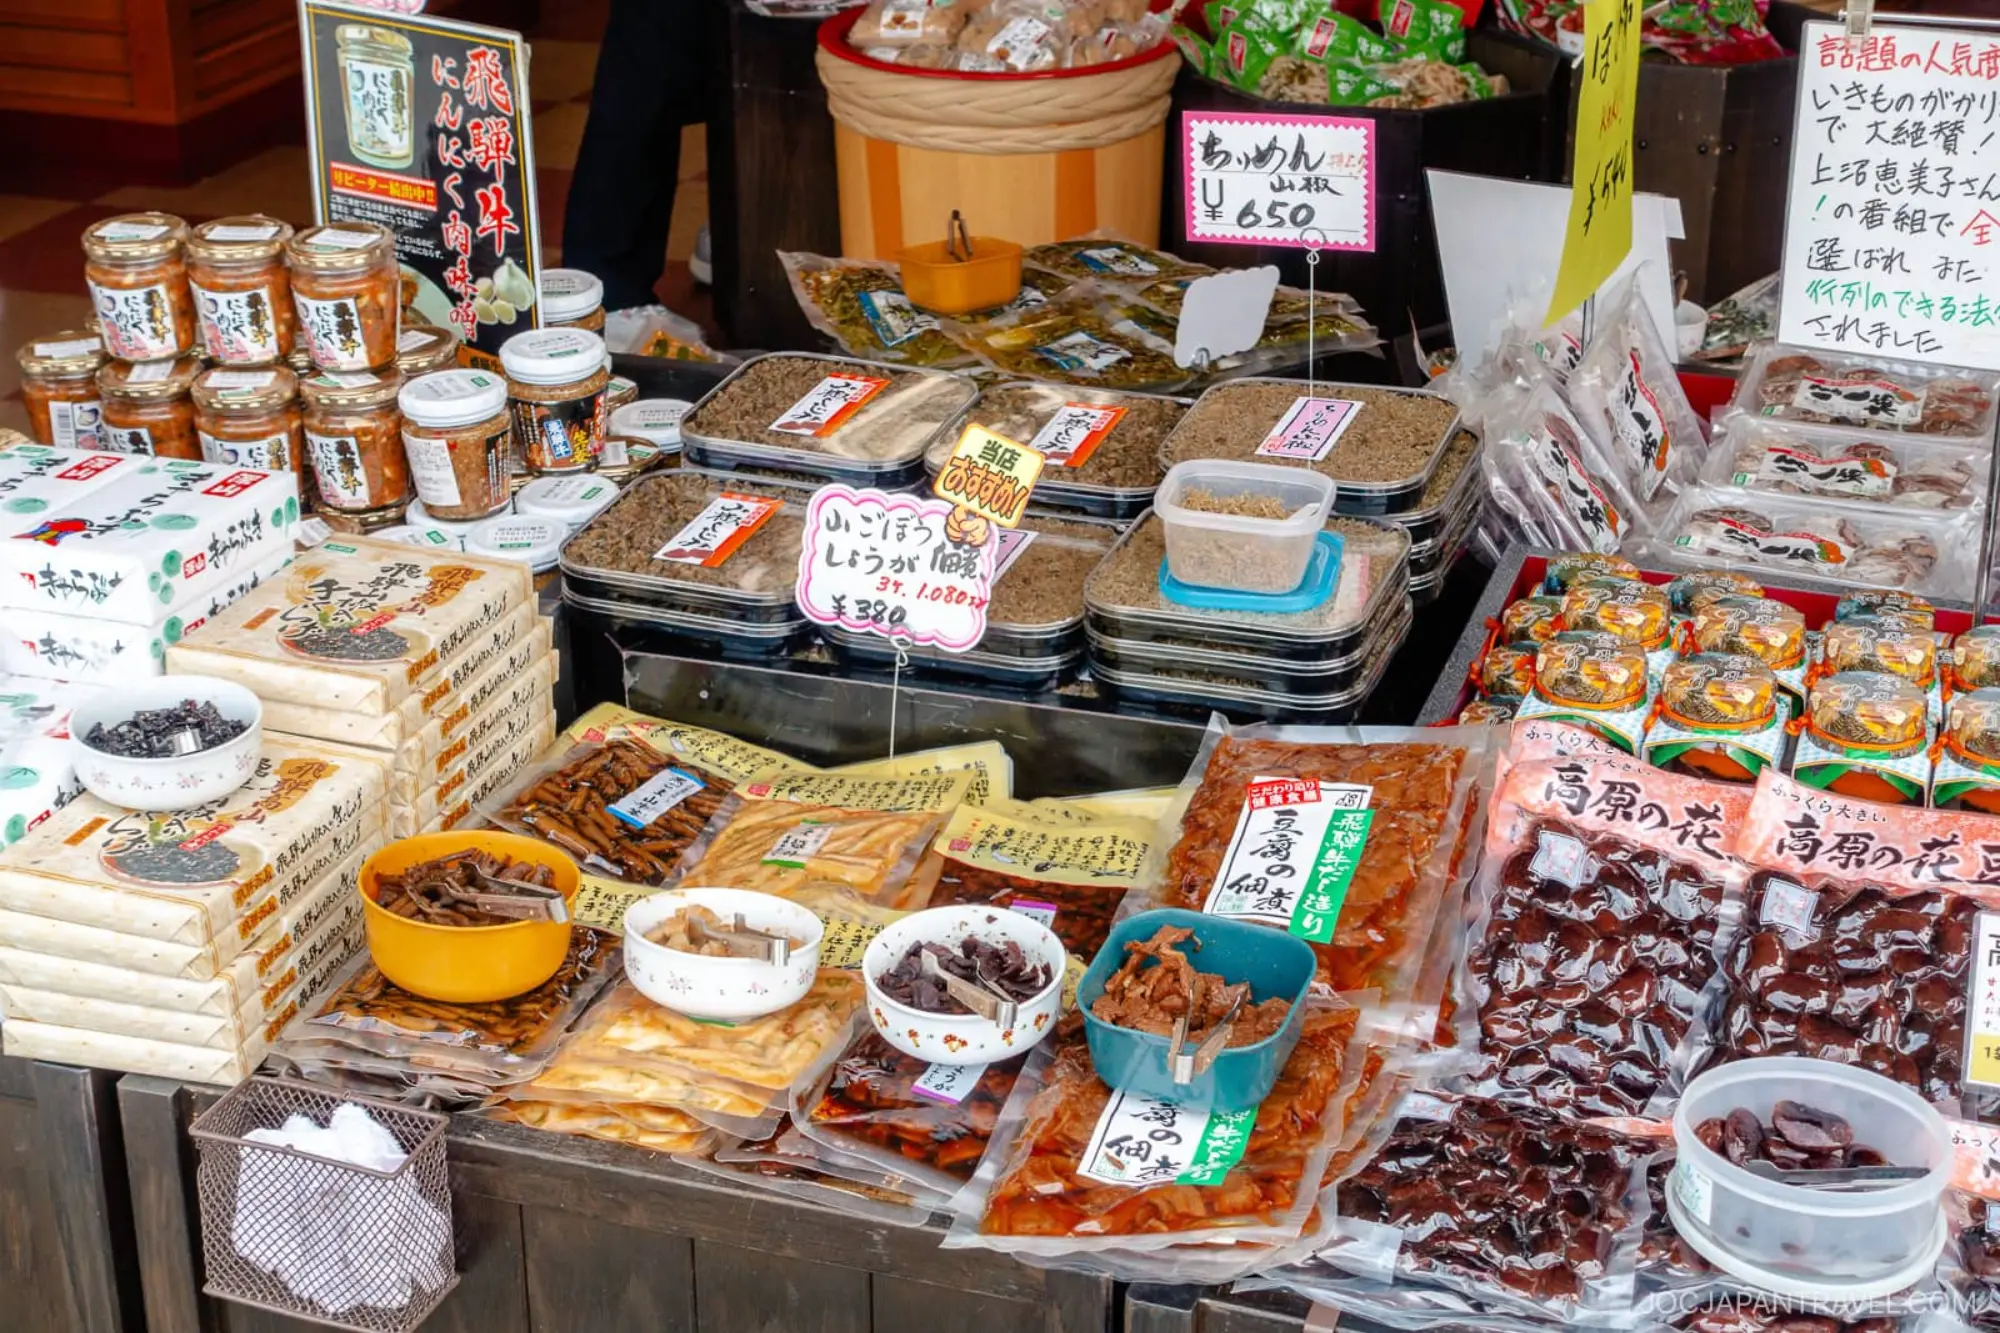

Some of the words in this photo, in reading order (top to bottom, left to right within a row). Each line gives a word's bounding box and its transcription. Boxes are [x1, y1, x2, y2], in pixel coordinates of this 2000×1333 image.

[1811, 82, 2000, 124] いきものがかり
[463, 46, 520, 256] 飛騨牛
[1817, 116, 1848, 144] で
[1199, 130, 1326, 174] ちりめん
[1269, 175, 1344, 196] 山椒
[1810, 152, 2000, 200] 上沼恵美子さん
[431, 53, 480, 343] にんにく肉味噌
[1236, 199, 1316, 229] 650
[1807, 237, 1911, 274] 選ばれ
[1932, 255, 1983, 283] また
[1805, 278, 2000, 327] 行列のできる法
[1803, 315, 1943, 353] されました
[978, 440, 1021, 472] 当店
[942, 455, 1029, 521] おすすめ!
[825, 508, 933, 546] 山ごぼう
[825, 542, 920, 576] しょうが
[831, 593, 908, 624] ¥380
[1544, 761, 1730, 863] 高原の花
[1772, 783, 1888, 824] ふっくら大きい
[1226, 809, 1305, 915] 豆腐の佃煮
[1106, 1098, 1185, 1180] 腐の佃煮
